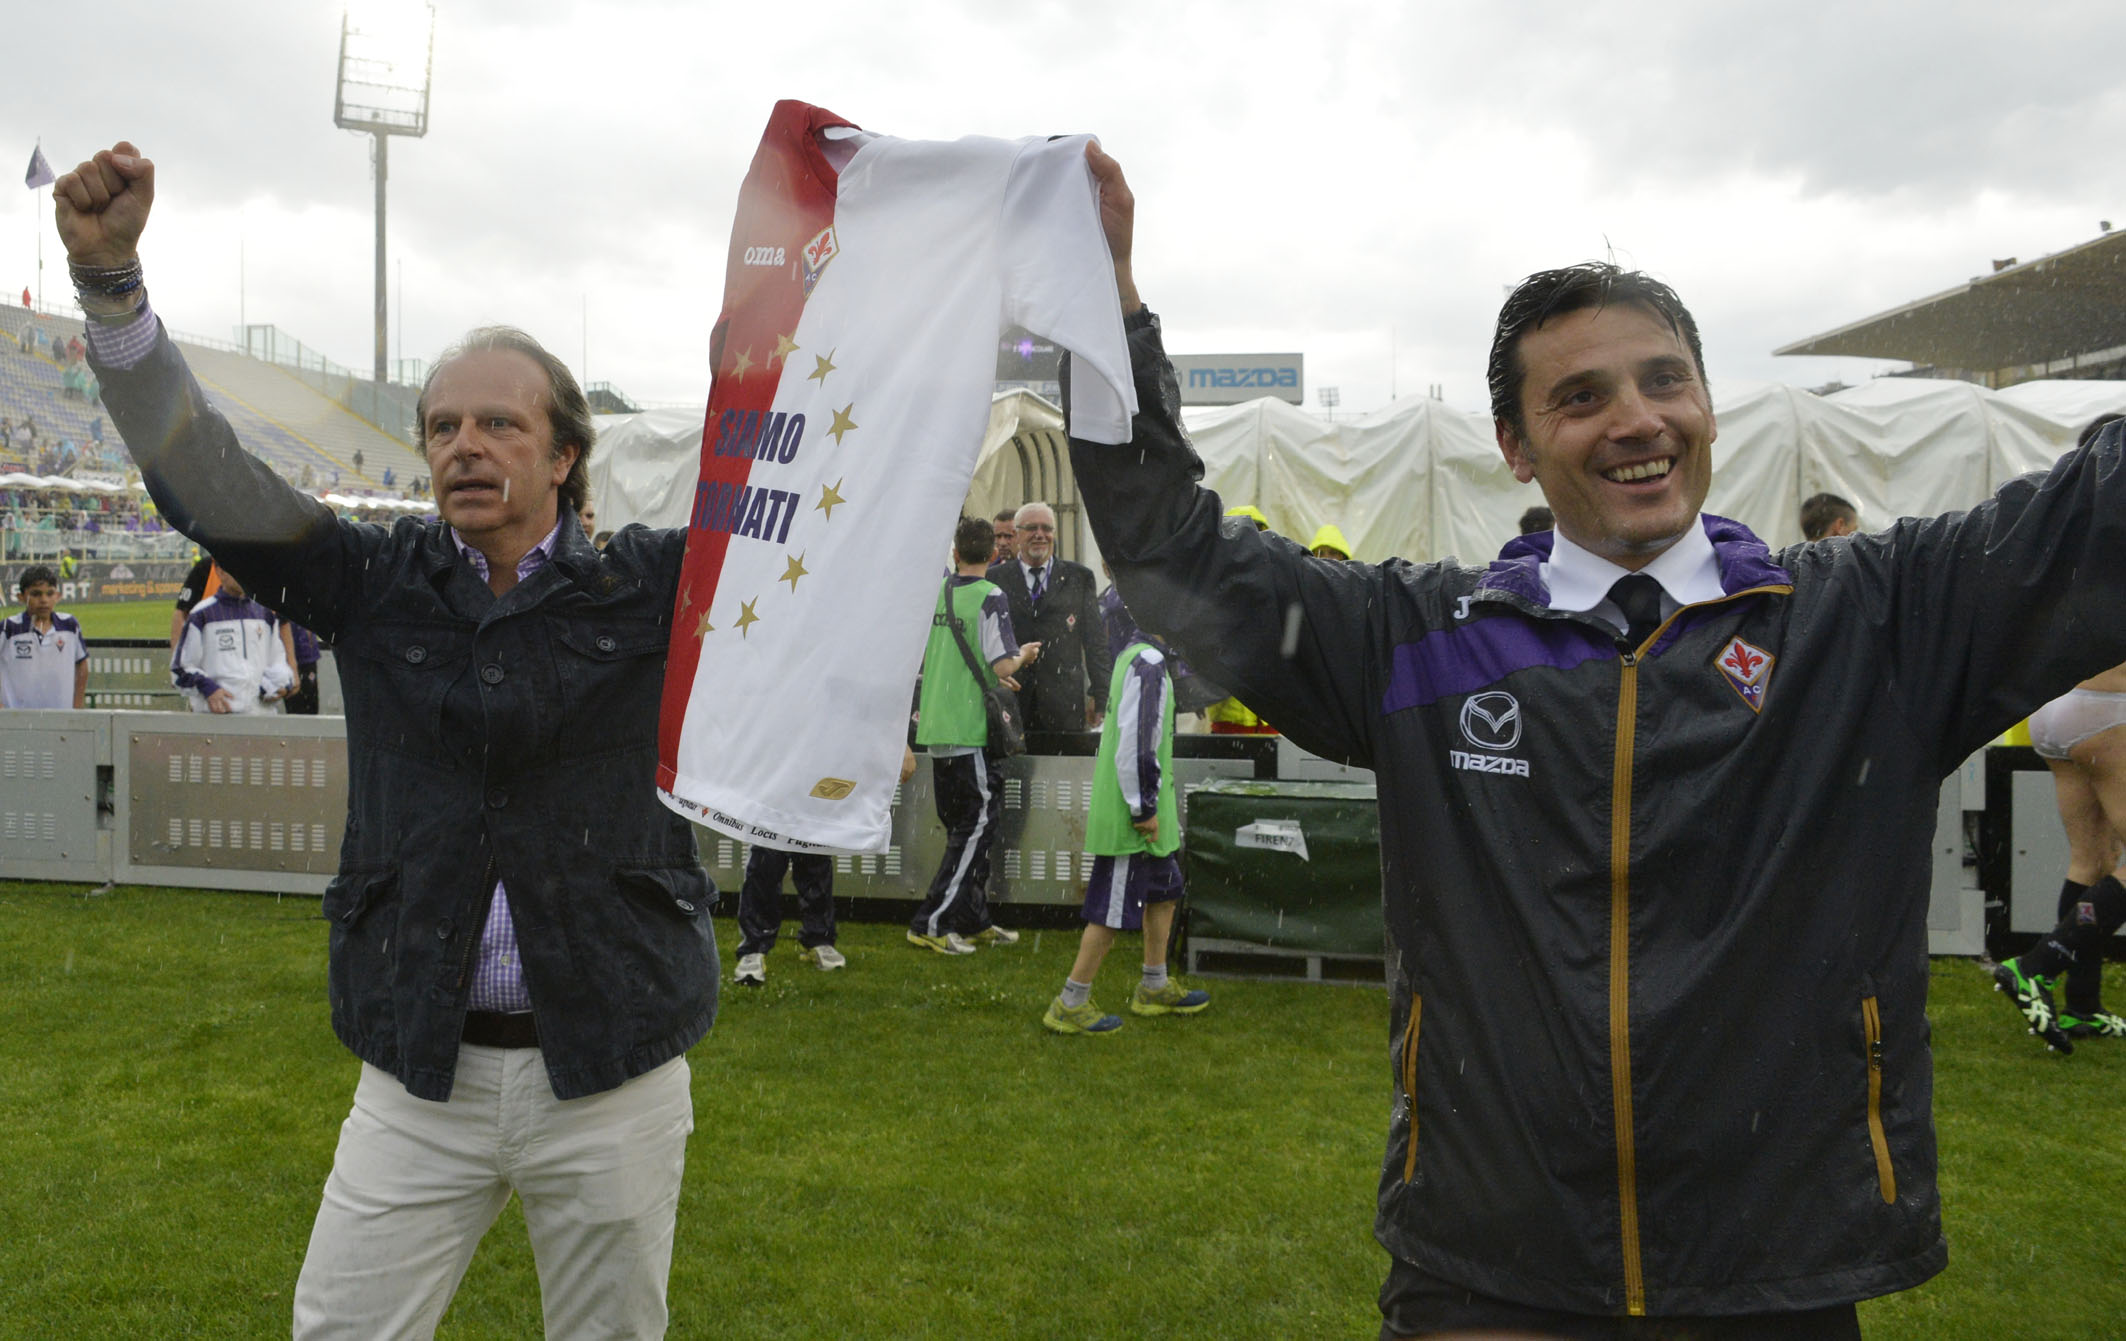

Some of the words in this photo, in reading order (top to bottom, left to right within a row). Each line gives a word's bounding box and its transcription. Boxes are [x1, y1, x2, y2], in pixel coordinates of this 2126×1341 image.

[1189, 367, 1298, 388] mazda
[714, 408, 806, 465] SIAMO
[693, 480, 801, 545] TORNATI
[1449, 750, 1530, 778] mazda
[712, 811, 745, 832] Omnibus
